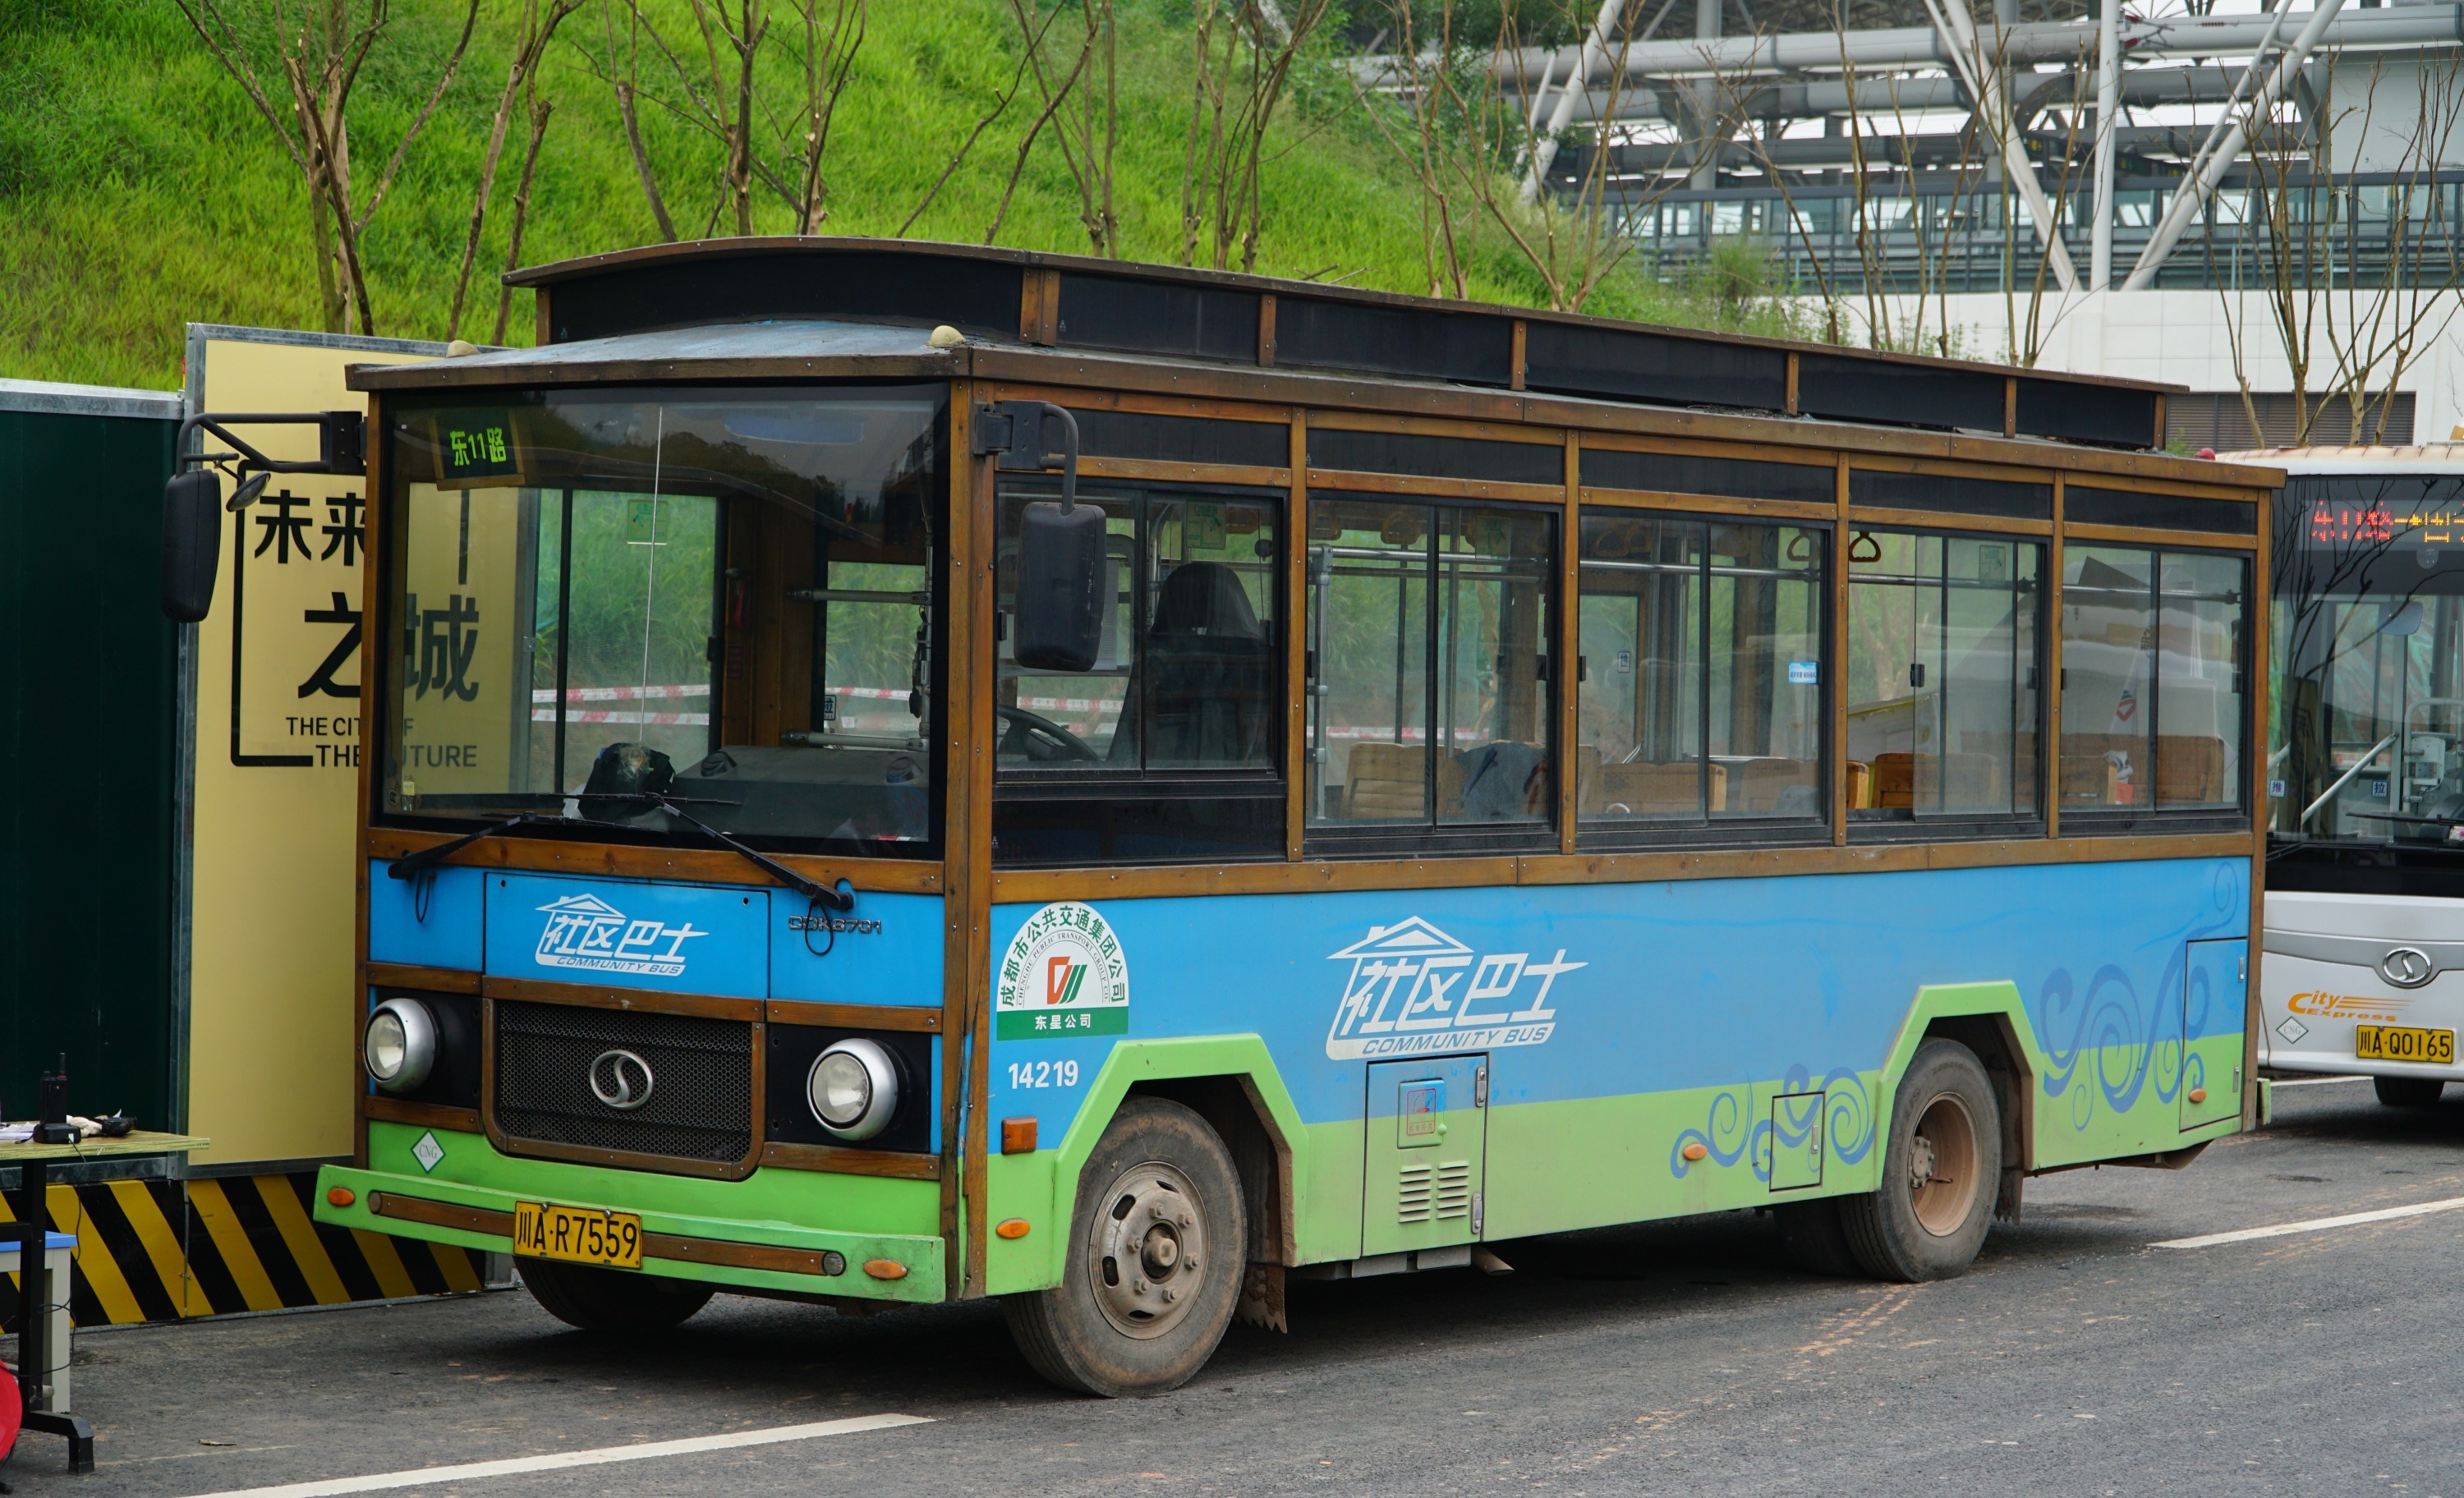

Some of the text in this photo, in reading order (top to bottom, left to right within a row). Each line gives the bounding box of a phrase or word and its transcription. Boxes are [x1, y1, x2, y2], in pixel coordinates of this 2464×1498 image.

[449, 427, 507, 466] 东11路
[285, 717, 328, 736] THE
[542, 914, 710, 963] 社区巴士
[556, 956, 681, 974] COMMUNITY BUS
[1000, 905, 1125, 1007] 成都市公共交通集团公司
[1018, 961, 1033, 1006] CHENGDU
[1032, 935, 1056, 959] PUBLIC
[1057, 932, 1094, 951] TRANSPORT
[1092, 952, 1107, 982] GROUP
[1339, 949, 1589, 1036] 社区巴士
[2287, 990, 2341, 1014] City
[1034, 1013, 1092, 1031] 东星公司
[2306, 1009, 2397, 1022] Express
[1362, 1027, 1549, 1055] COMMUNITY BUS
[2283, 1026, 2301, 1035] CNG
[1008, 1059, 1078, 1090] 14219
[419, 1144, 437, 1160] CNG
